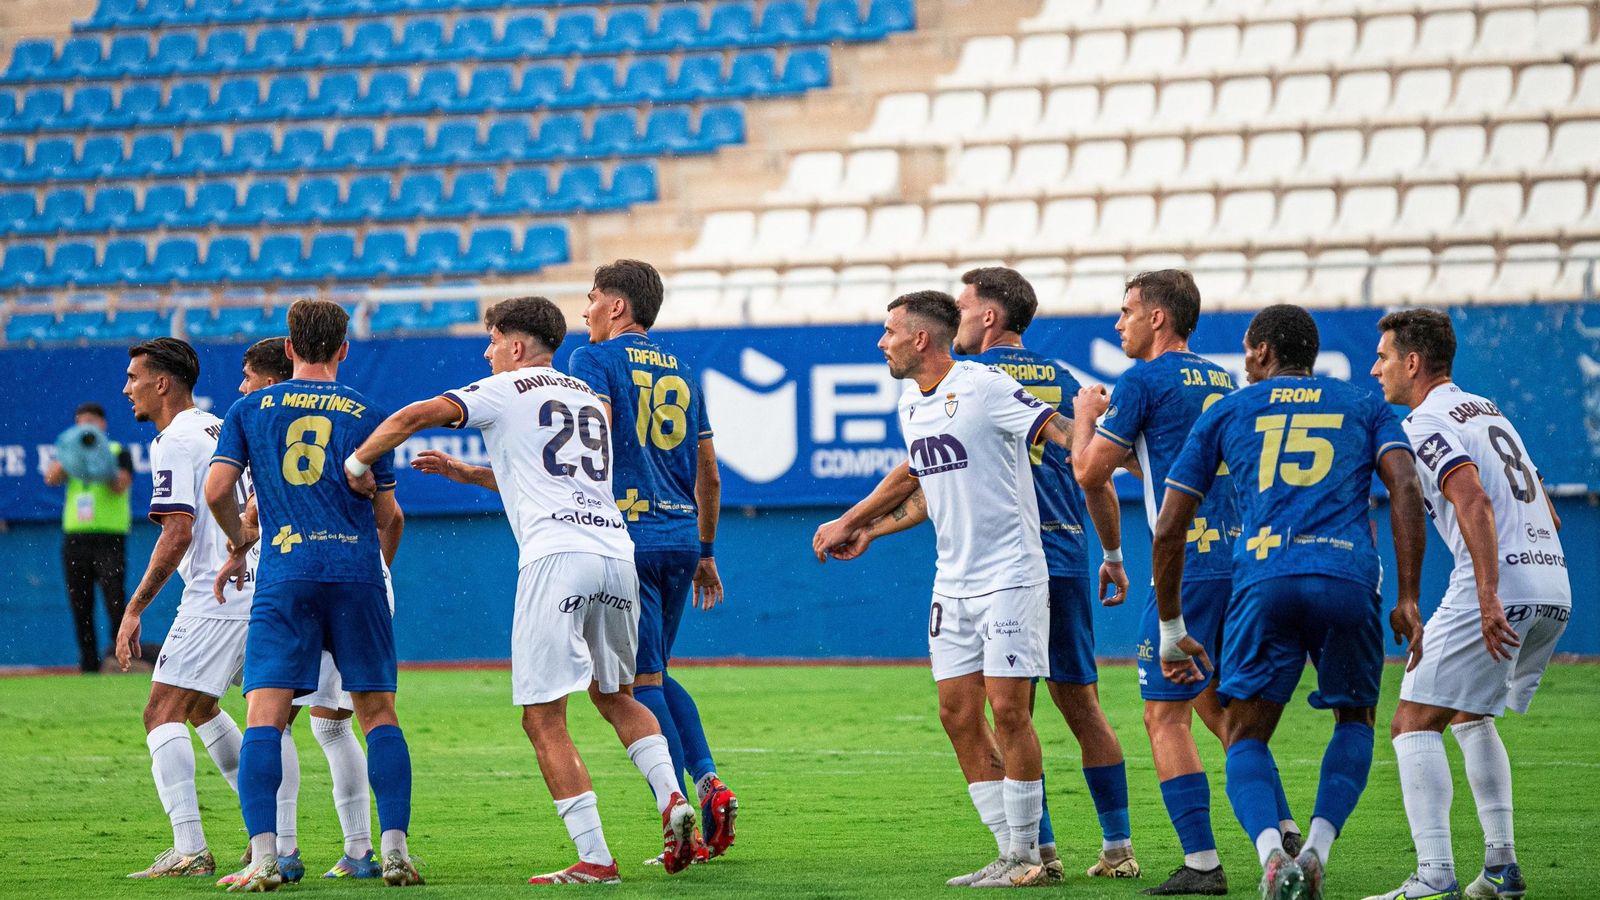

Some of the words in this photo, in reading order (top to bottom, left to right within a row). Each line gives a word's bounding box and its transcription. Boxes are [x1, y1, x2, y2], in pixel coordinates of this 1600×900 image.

[625, 347, 678, 370] TAFALLA
[514, 374, 558, 394] DAVID
[1180, 368, 1207, 386] J.A.
[1207, 369, 1234, 390] RUIZ
[260, 395, 276, 410] A.
[281, 393, 367, 419] MARTÍNEZ
[631, 369, 691, 451] 18
[1269, 388, 1322, 404] FROM
[282, 415, 333, 486] 8
[538, 399, 610, 482] 29
[1255, 413, 1345, 493] 15
[811, 450, 908, 479] COMPO
[1488, 425, 1537, 504] 8
